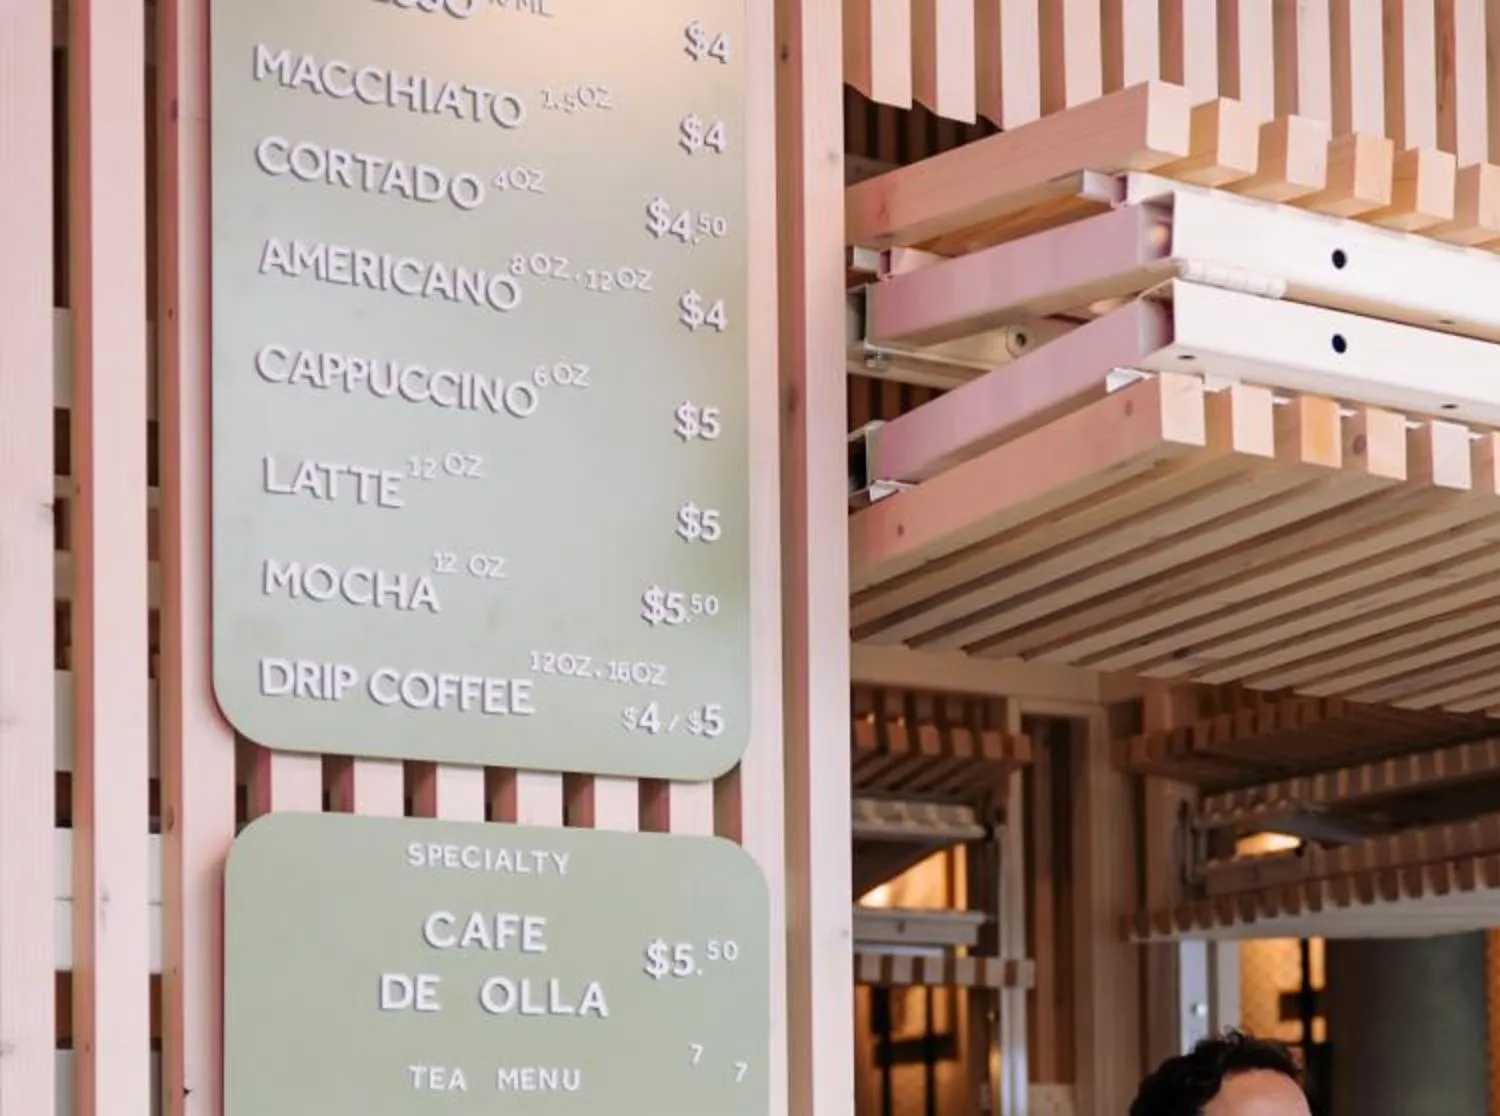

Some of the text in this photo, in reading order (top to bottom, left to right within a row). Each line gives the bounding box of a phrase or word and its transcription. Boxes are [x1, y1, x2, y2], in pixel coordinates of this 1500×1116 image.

[684, 20, 730, 63] $4
[253, 43, 526, 129] MACCHIATO
[679, 112, 727, 154] $4
[255, 136, 486, 211] CORTADO
[259, 237, 523, 313] AMERICANO
[678, 290, 728, 333] $4
[254, 343, 539, 419] CAPPUCCINO
[673, 399, 721, 441] $5
[262, 454, 406, 509] LATTE
[674, 500, 722, 543] $5
[262, 558, 442, 613] MOCHA
[259, 656, 360, 700] DRIP
[368, 668, 537, 716] COFFEE
[687, 704, 725, 738] $5
[406, 842, 572, 876] SPECIALTY
[424, 911, 548, 954] CAFE
[379, 972, 610, 1018] DE OLLA
[409, 1064, 582, 1092] TEA MENU
